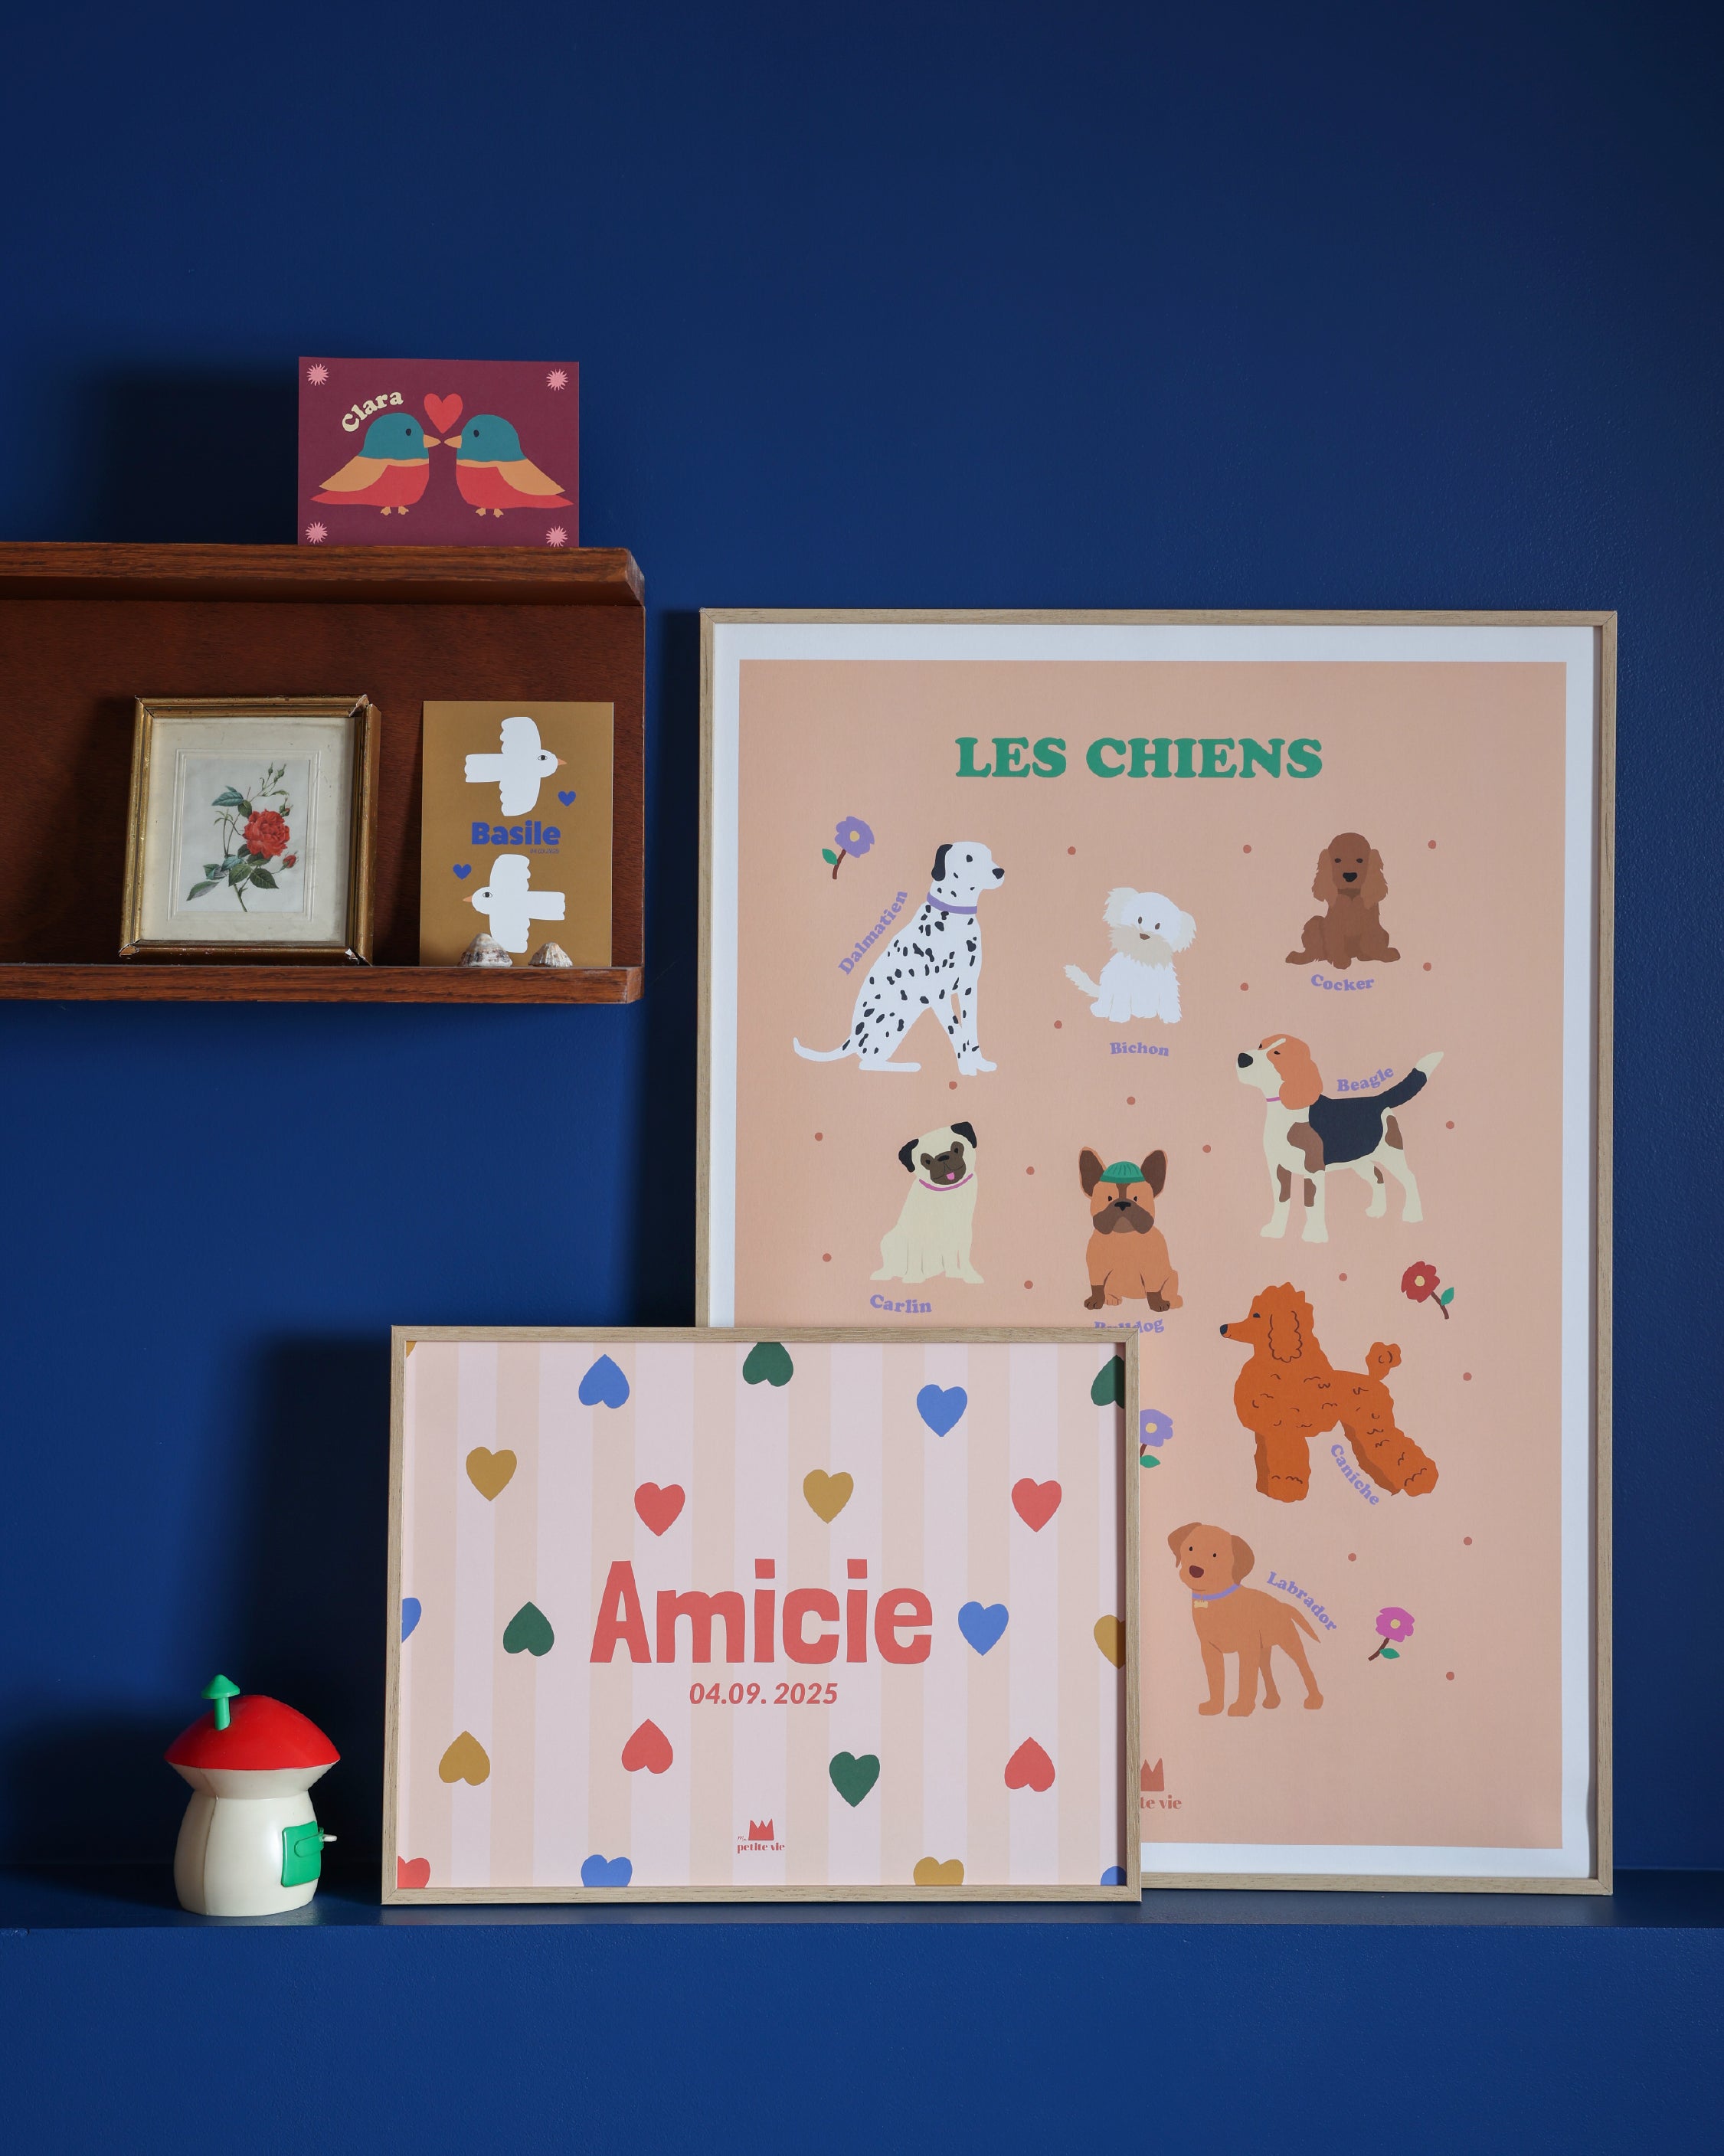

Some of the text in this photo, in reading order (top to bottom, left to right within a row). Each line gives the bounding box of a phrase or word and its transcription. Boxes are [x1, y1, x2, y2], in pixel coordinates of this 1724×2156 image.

[342, 391, 404, 432] Clara
[955, 737, 1323, 779] LES CHIENS
[471, 820, 561, 846] Basile
[838, 891, 908, 975] Dalmatien
[1310, 973, 1375, 991] Cocker
[1109, 1042, 1170, 1057] Bichon
[1336, 1068, 1394, 1091] Beagle
[869, 1294, 932, 1314] Carlin
[1330, 1444, 1379, 1506] Caniche
[589, 1558, 933, 1664] Amicie
[1266, 1571, 1337, 1630] Labrador
[773, 1682, 838, 1705] 2025
[1159, 1794, 1182, 1809] vie
[737, 1842, 786, 1854] petite vie
